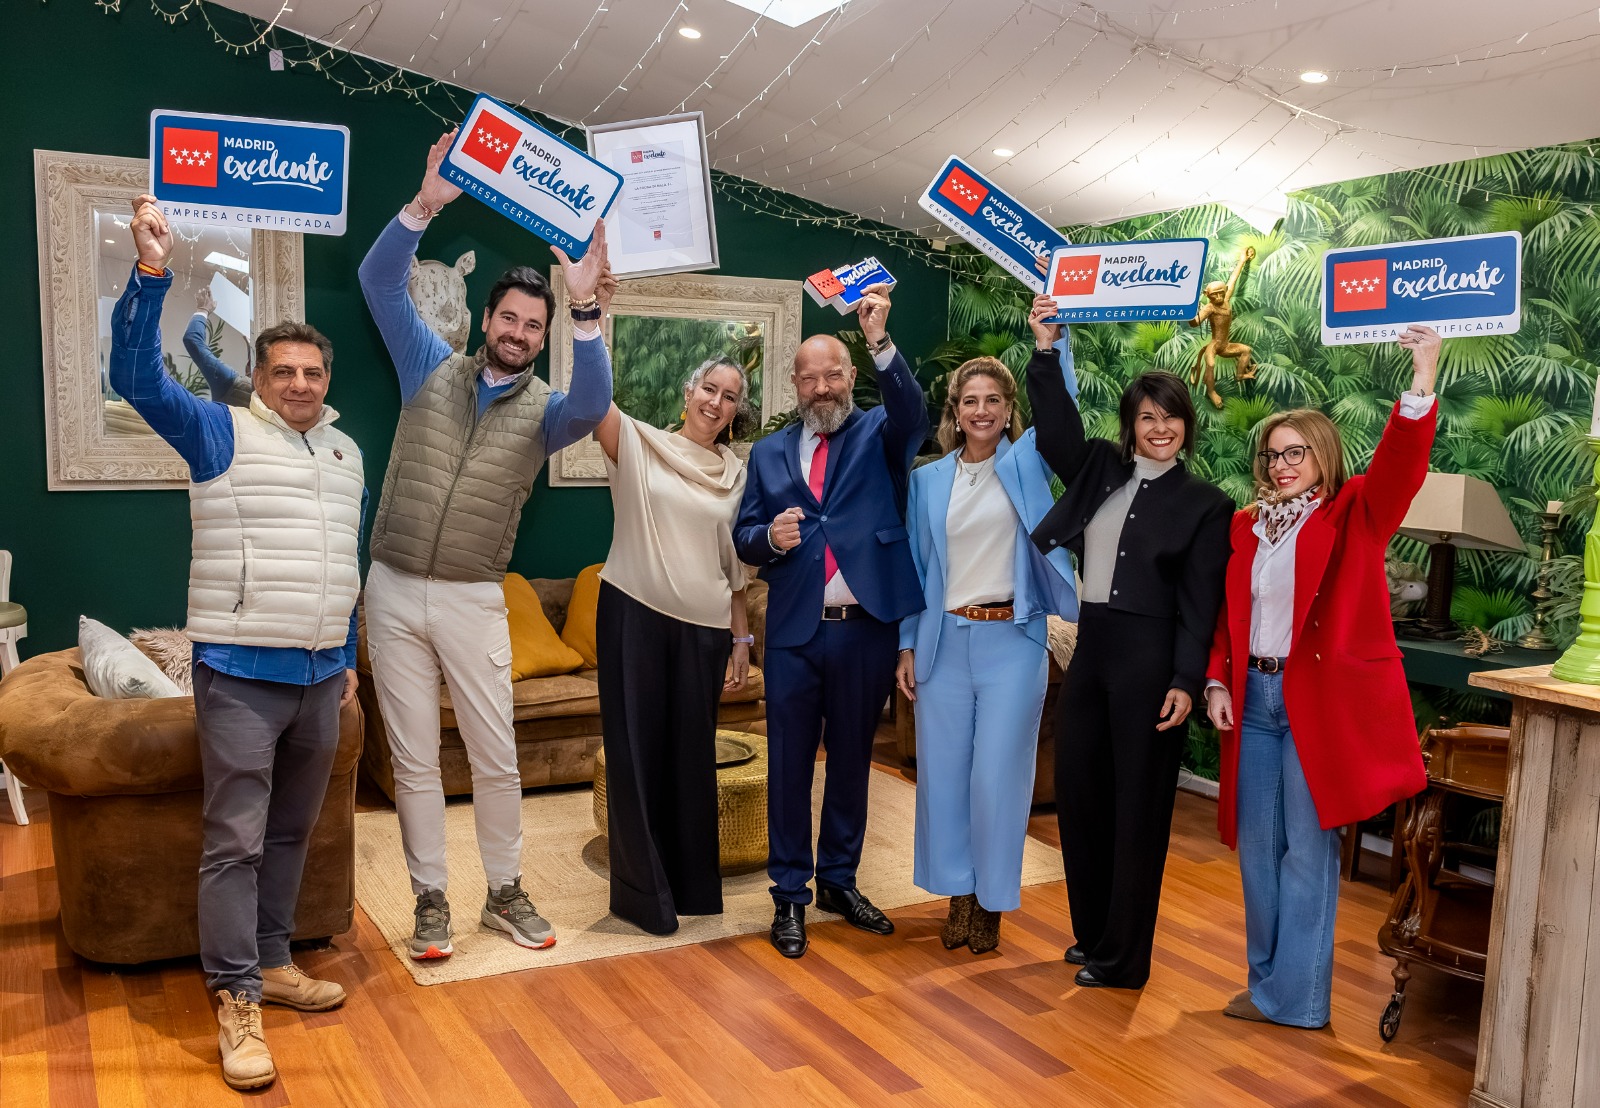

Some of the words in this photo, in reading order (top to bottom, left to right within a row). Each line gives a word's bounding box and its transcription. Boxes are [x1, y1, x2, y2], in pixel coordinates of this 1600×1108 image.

[224, 137, 275, 151] MADRID
[522, 139, 562, 167] MADRID
[223, 149, 334, 184] excelente
[512, 154, 596, 211] excelente
[163, 207, 228, 221] EMPRESA
[236, 213, 332, 229] CERTIFICADA
[449, 170, 497, 203] EMPRESA
[502, 202, 574, 250] CERTIFICADA
[988, 196, 1023, 223] MADRID
[928, 203, 972, 236] EMPRESA
[976, 237, 1037, 286] CERTIFICADA
[982, 205, 1052, 258] excelente
[1101, 259, 1191, 287] excelente
[1104, 255, 1145, 265] MADRID
[1392, 257, 1443, 272] MADRID
[1392, 260, 1505, 298] excelente
[1049, 310, 1099, 320] MPRESA
[1105, 308, 1184, 318] CERTIFICADA
[1335, 329, 1397, 341] EMPRESA
[1406, 321, 1504, 334] TIFICADA
